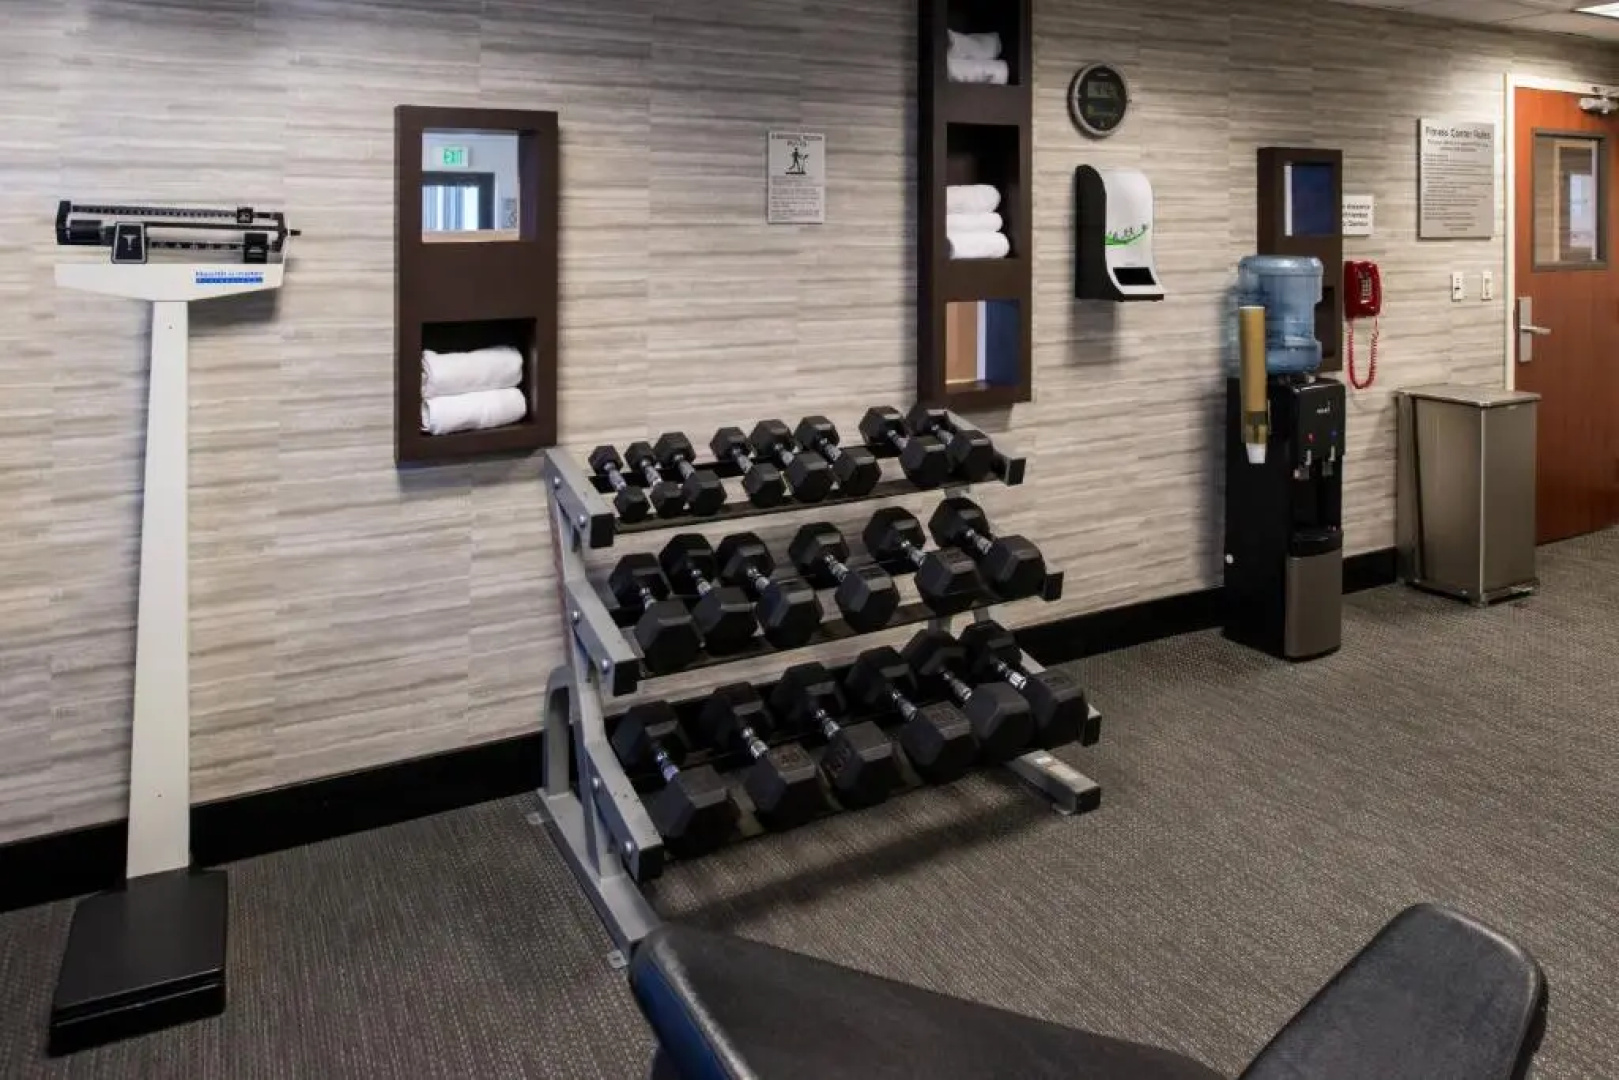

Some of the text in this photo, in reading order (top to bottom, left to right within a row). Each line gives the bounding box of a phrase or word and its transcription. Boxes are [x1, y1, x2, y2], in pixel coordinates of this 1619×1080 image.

[1425, 126, 1449, 137] Fitness
[1450, 128, 1473, 138] Center
[443, 148, 463, 164] EXIT
